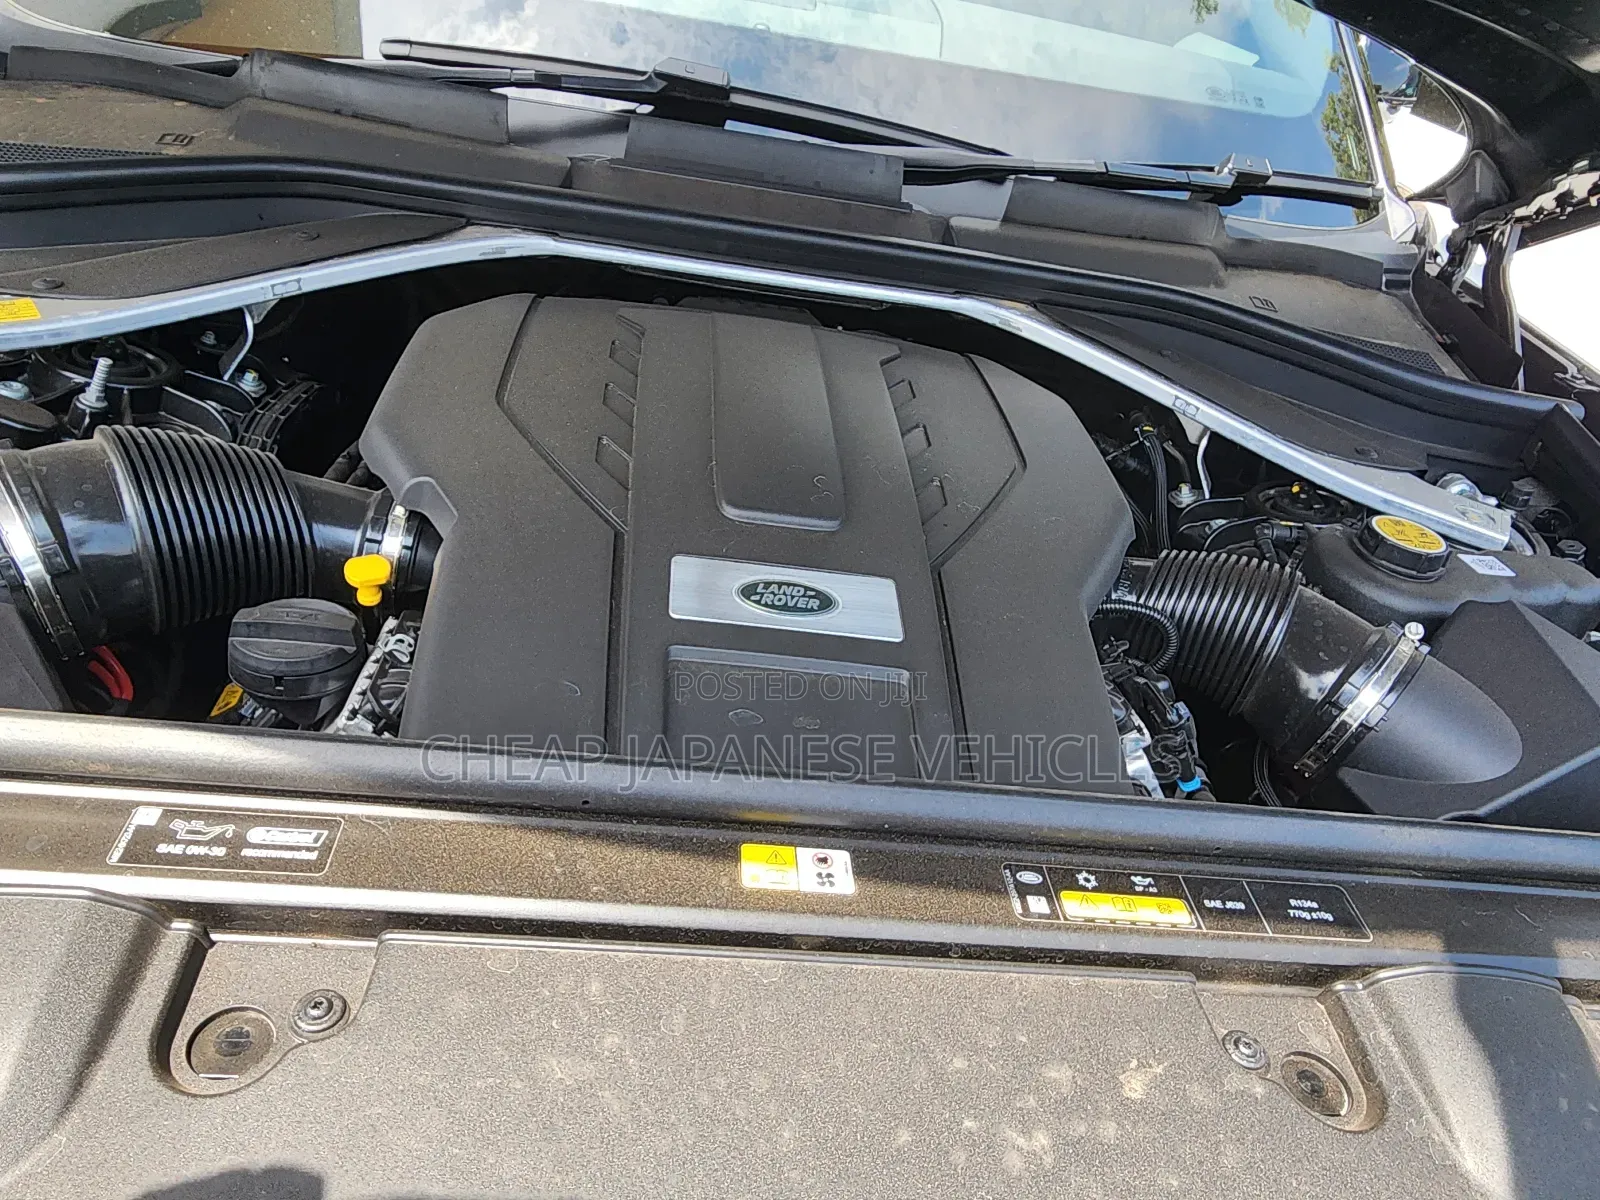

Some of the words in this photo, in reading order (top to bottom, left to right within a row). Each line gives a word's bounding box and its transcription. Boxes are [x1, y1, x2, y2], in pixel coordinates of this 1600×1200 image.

[756, 582, 805, 596] LAND
[760, 593, 821, 611] ROVER
[156, 843, 186, 855] SAE
[1289, 898, 1319, 909] R134a
